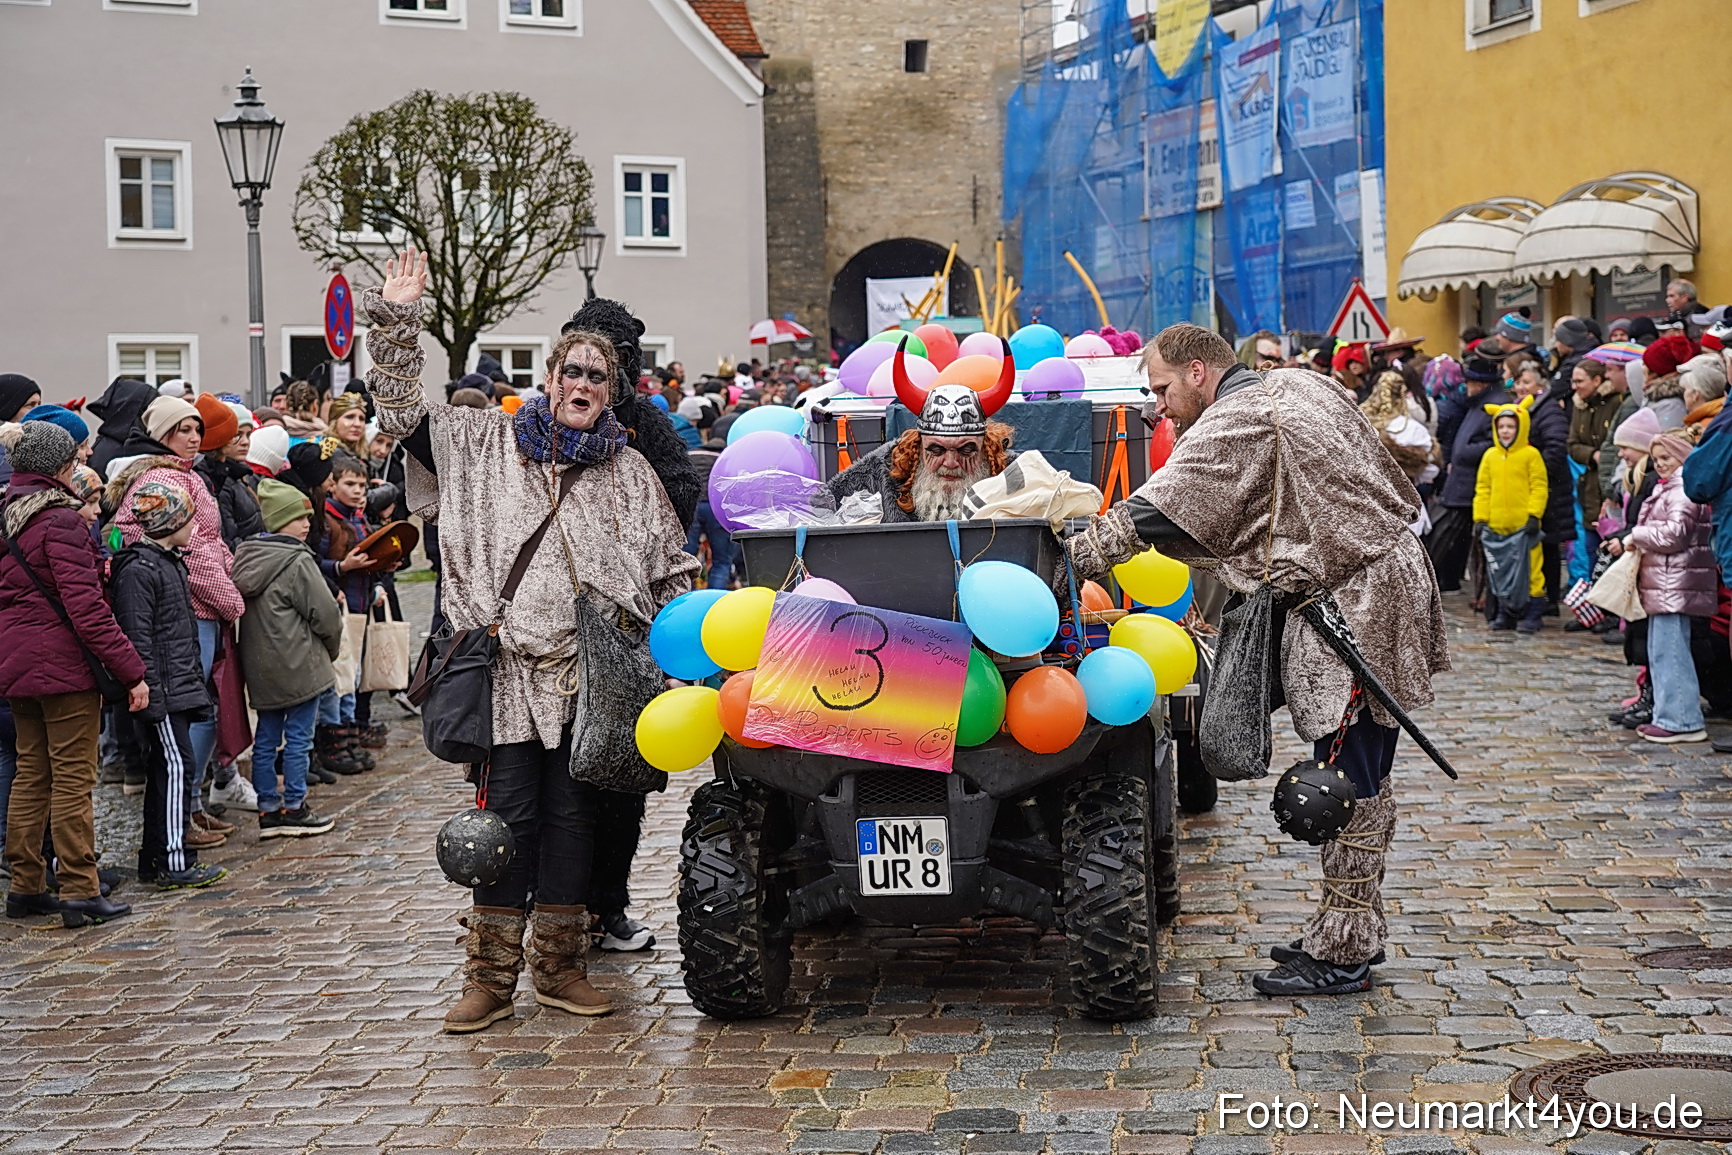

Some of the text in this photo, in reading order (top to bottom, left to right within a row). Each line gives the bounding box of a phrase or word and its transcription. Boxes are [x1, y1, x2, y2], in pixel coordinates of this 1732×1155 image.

[922, 641, 943, 655] 50
[812, 611, 889, 711] 3
[828, 664, 857, 678] HELAU
[841, 672, 871, 688] HELAU
[831, 685, 862, 701] HELAU
[864, 824, 923, 855] D NM
[868, 858, 941, 889] UR 8
